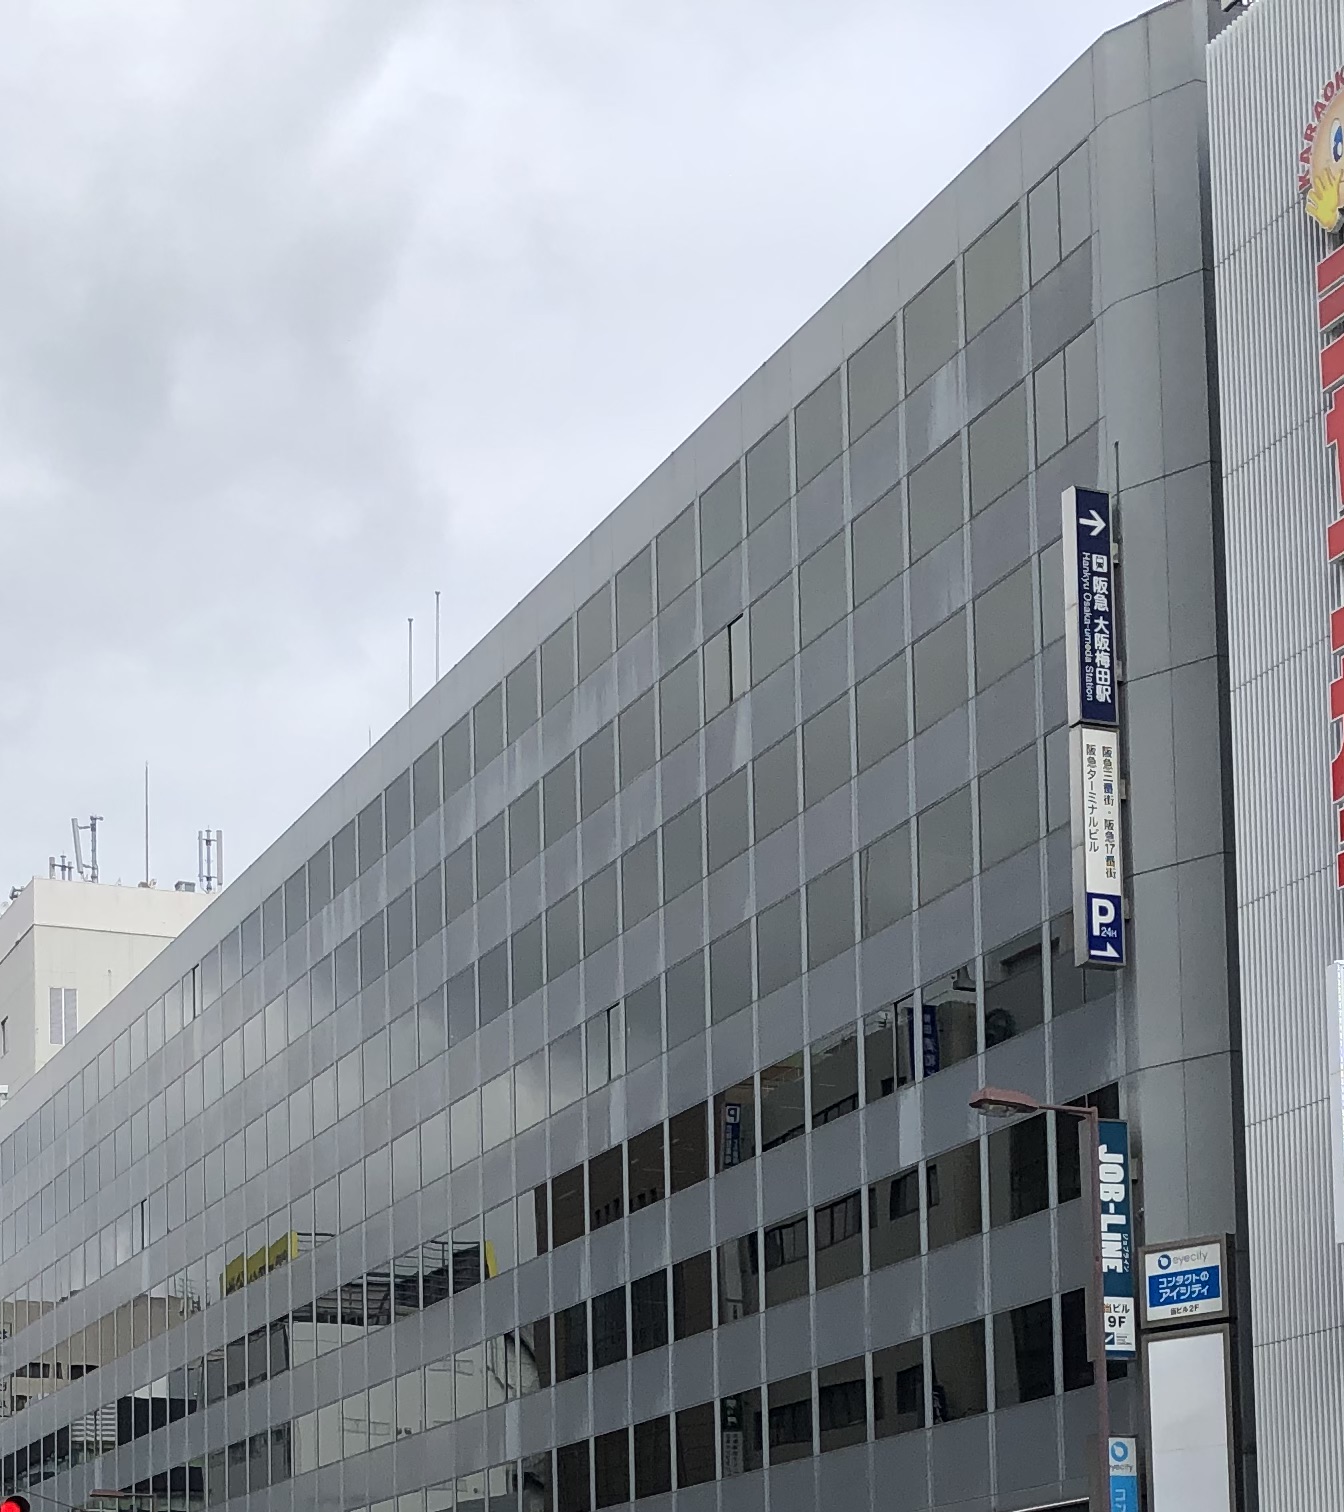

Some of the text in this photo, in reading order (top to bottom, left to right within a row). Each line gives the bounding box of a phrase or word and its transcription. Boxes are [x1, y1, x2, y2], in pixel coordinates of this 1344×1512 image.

[1082, 551, 1091, 590] Hankyu
[1093, 576, 1112, 704] 阪急 大阪梅田駅
[1084, 664, 1094, 702] Station
[1086, 743, 1099, 853] 阪急ターミナルビル
[1092, 897, 1116, 937] P
[1100, 926, 1118, 938] 24H
[1098, 1144, 1127, 1274] JOB-LINE
[1172, 1249, 1208, 1266] eyecity
[1158, 1271, 1210, 1288] コンタクトの
[1158, 1284, 1210, 1302] アイシティ
[1108, 1315, 1126, 1329] 9F
[1110, 1463, 1134, 1473] yecity
